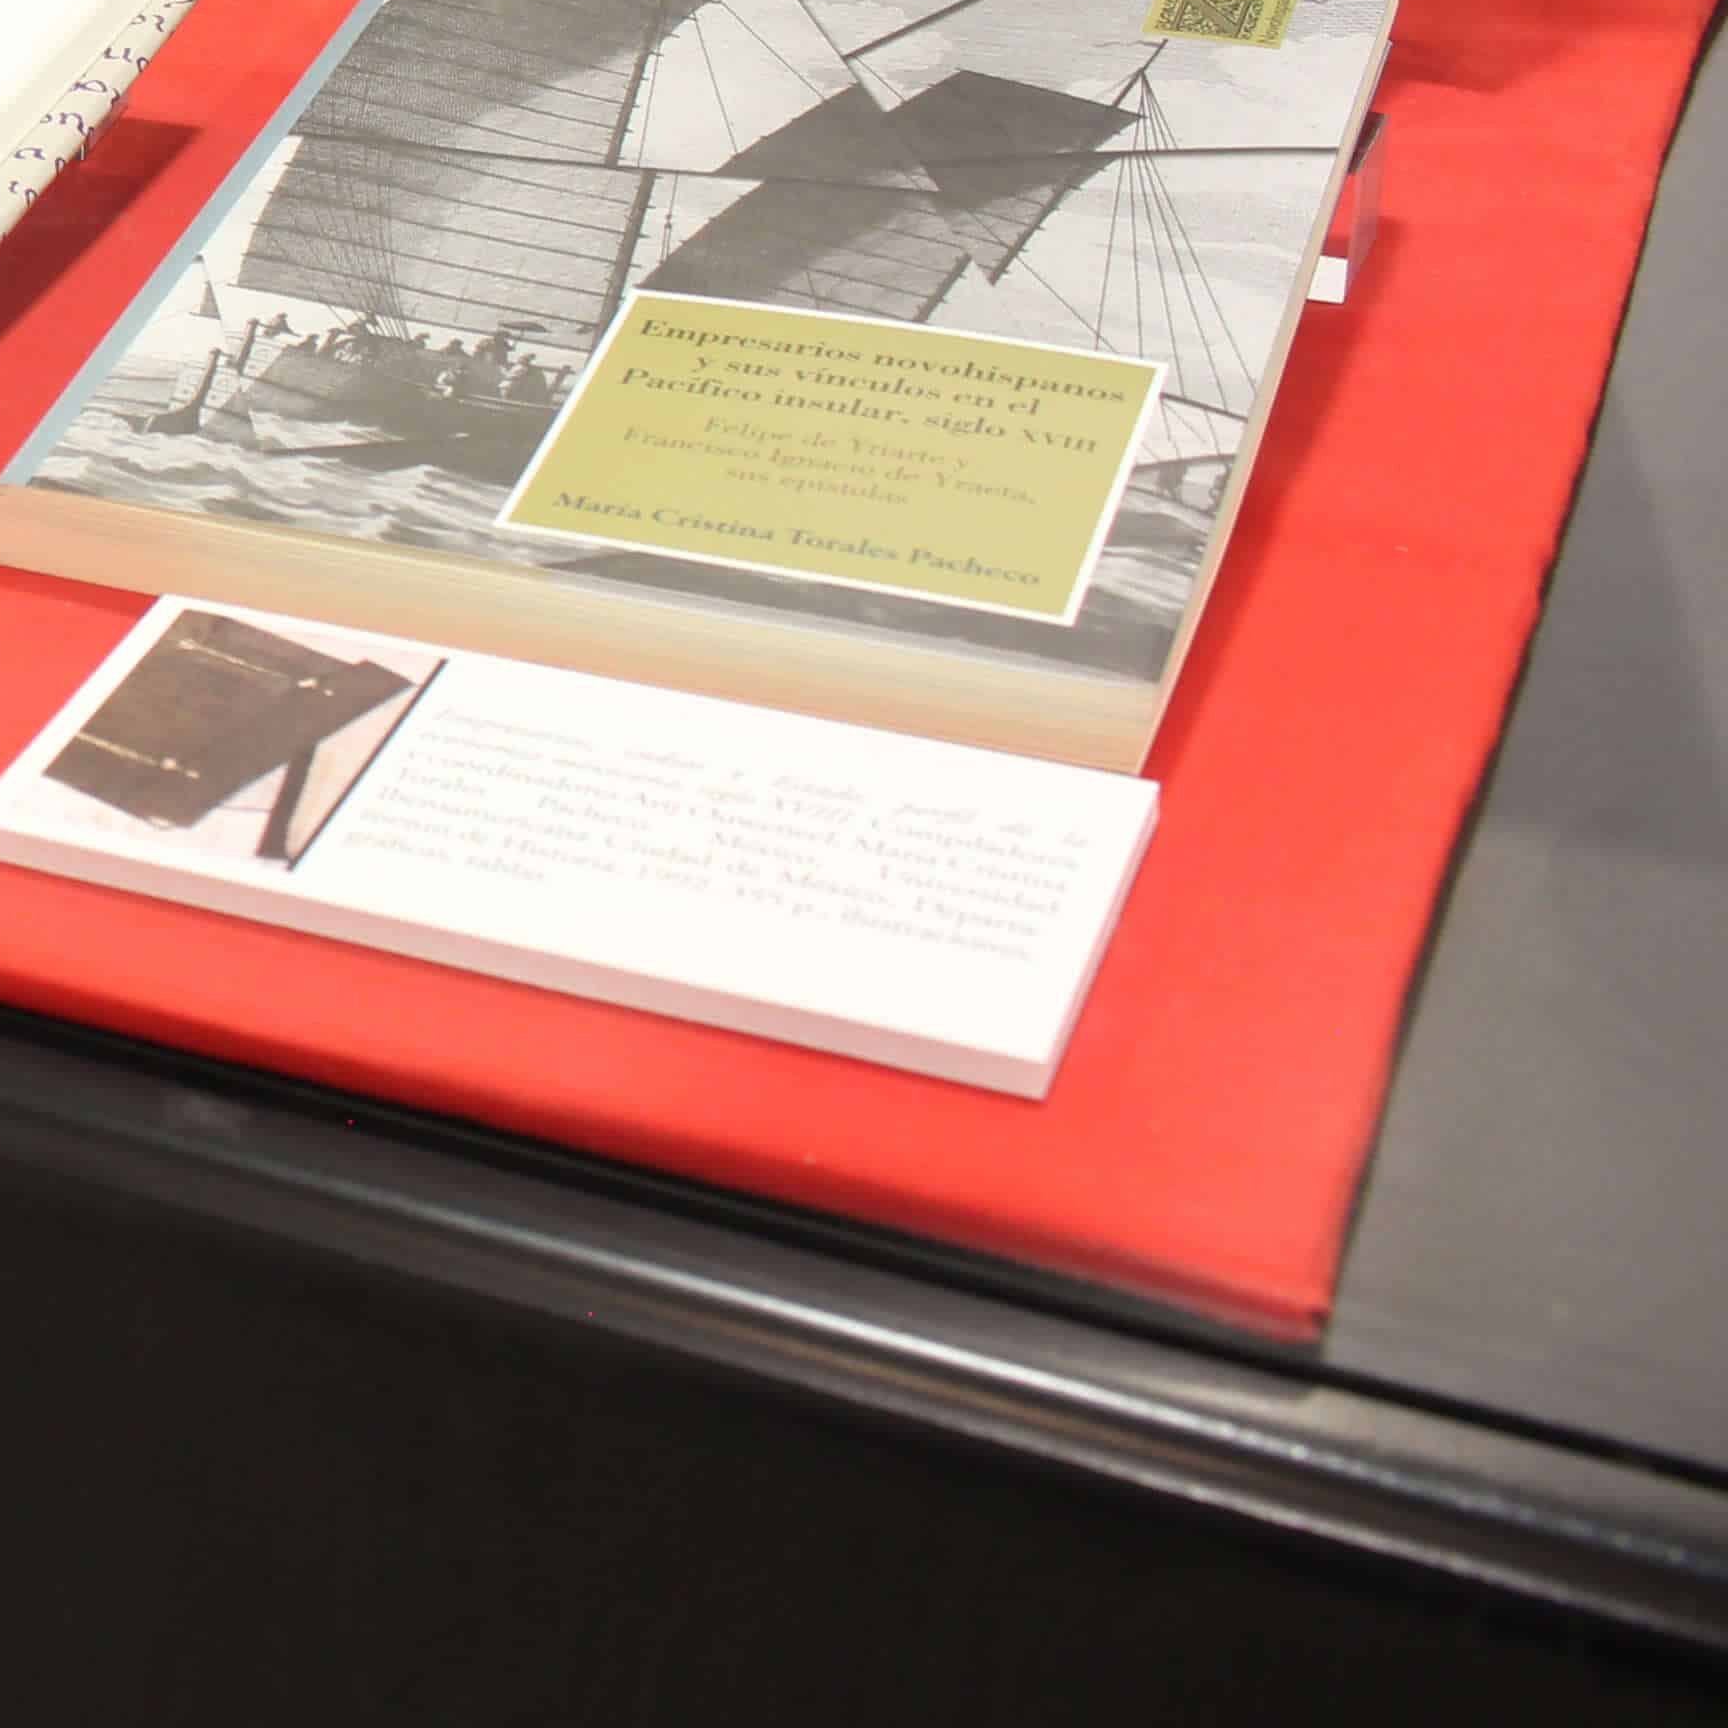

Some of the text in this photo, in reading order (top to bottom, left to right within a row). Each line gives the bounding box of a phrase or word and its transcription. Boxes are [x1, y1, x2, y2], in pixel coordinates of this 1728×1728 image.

[639, 318, 1124, 401] Empresarios novohispanos
[726, 361, 780, 376] sus
[795, 369, 940, 399] vínculos
[952, 393, 995, 408] en
[1007, 397, 1040, 416] el
[620, 367, 762, 401] Pacífico
[924, 415, 1006, 437] siglo
[1022, 428, 1096, 453] XVIII
[650, 508, 774, 541] Cristina
[790, 528, 898, 560] Torales
[907, 547, 1040, 585] Pacheco
